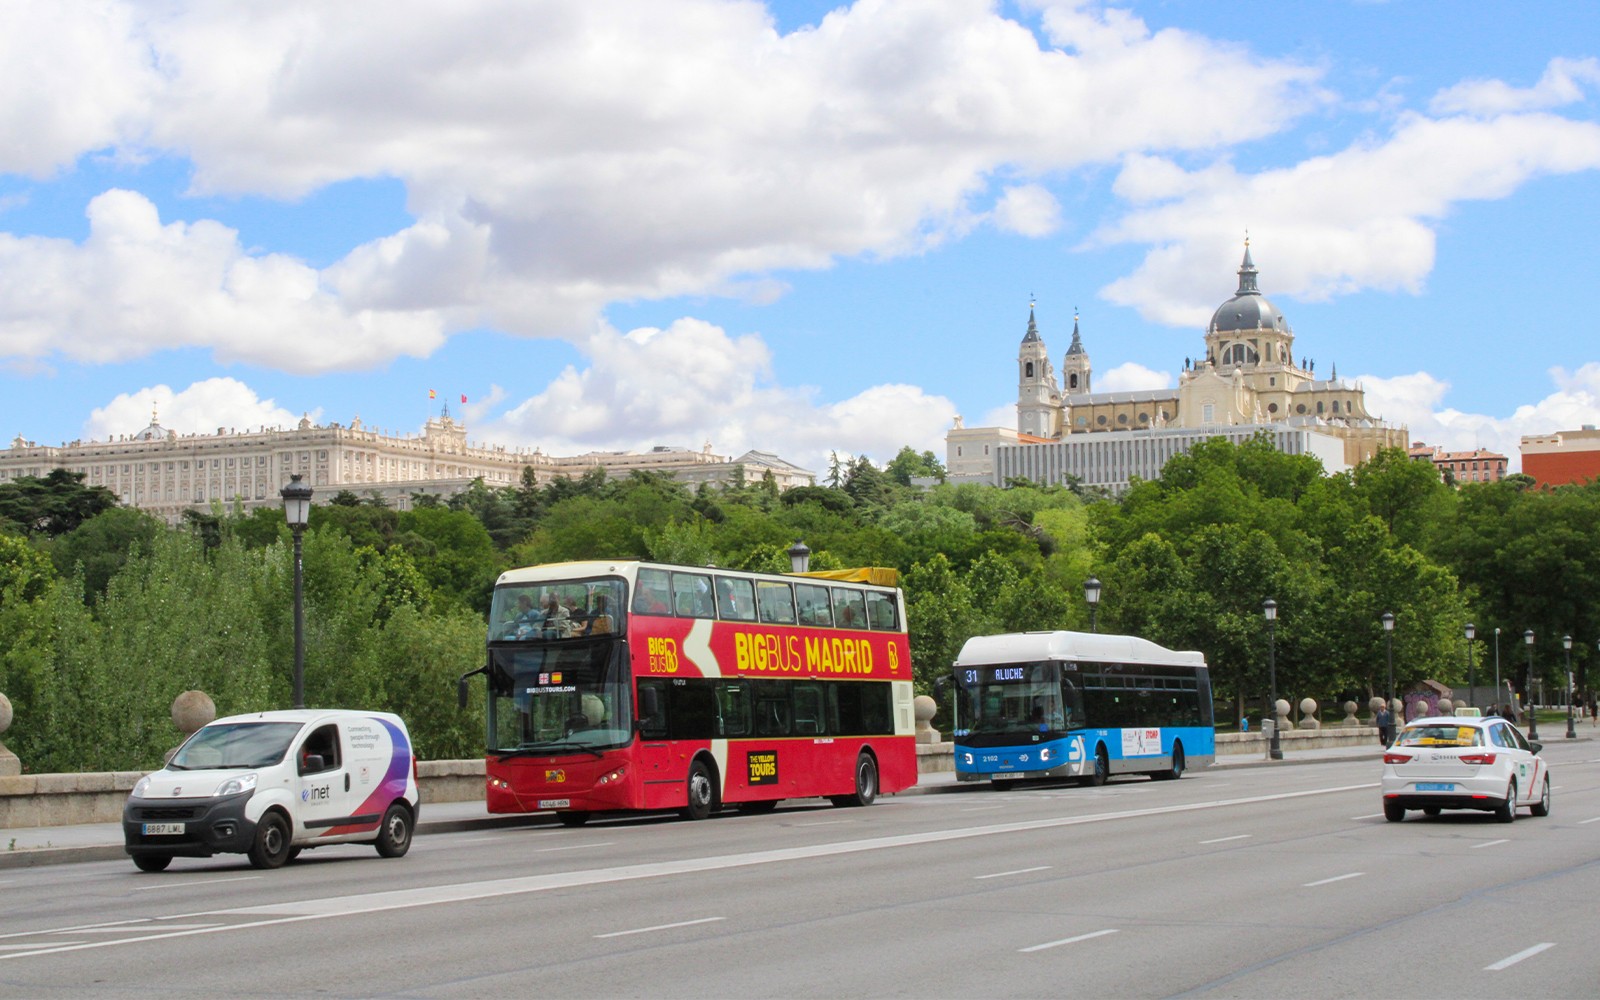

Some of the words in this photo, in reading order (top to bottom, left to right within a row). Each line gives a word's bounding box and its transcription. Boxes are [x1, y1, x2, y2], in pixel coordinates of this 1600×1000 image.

[648, 637, 665, 655] BIG
[805, 636, 873, 674] MADRID
[650, 655, 666, 673] BUS
[966, 670, 978, 682] 31
[995, 668, 1024, 680] ALUCHE
[526, 685, 576, 694] BIGBUSTOURS.COM
[750, 755, 758, 763] THE
[750, 762, 776, 776] TOURS
[311, 784, 330, 800] inet
